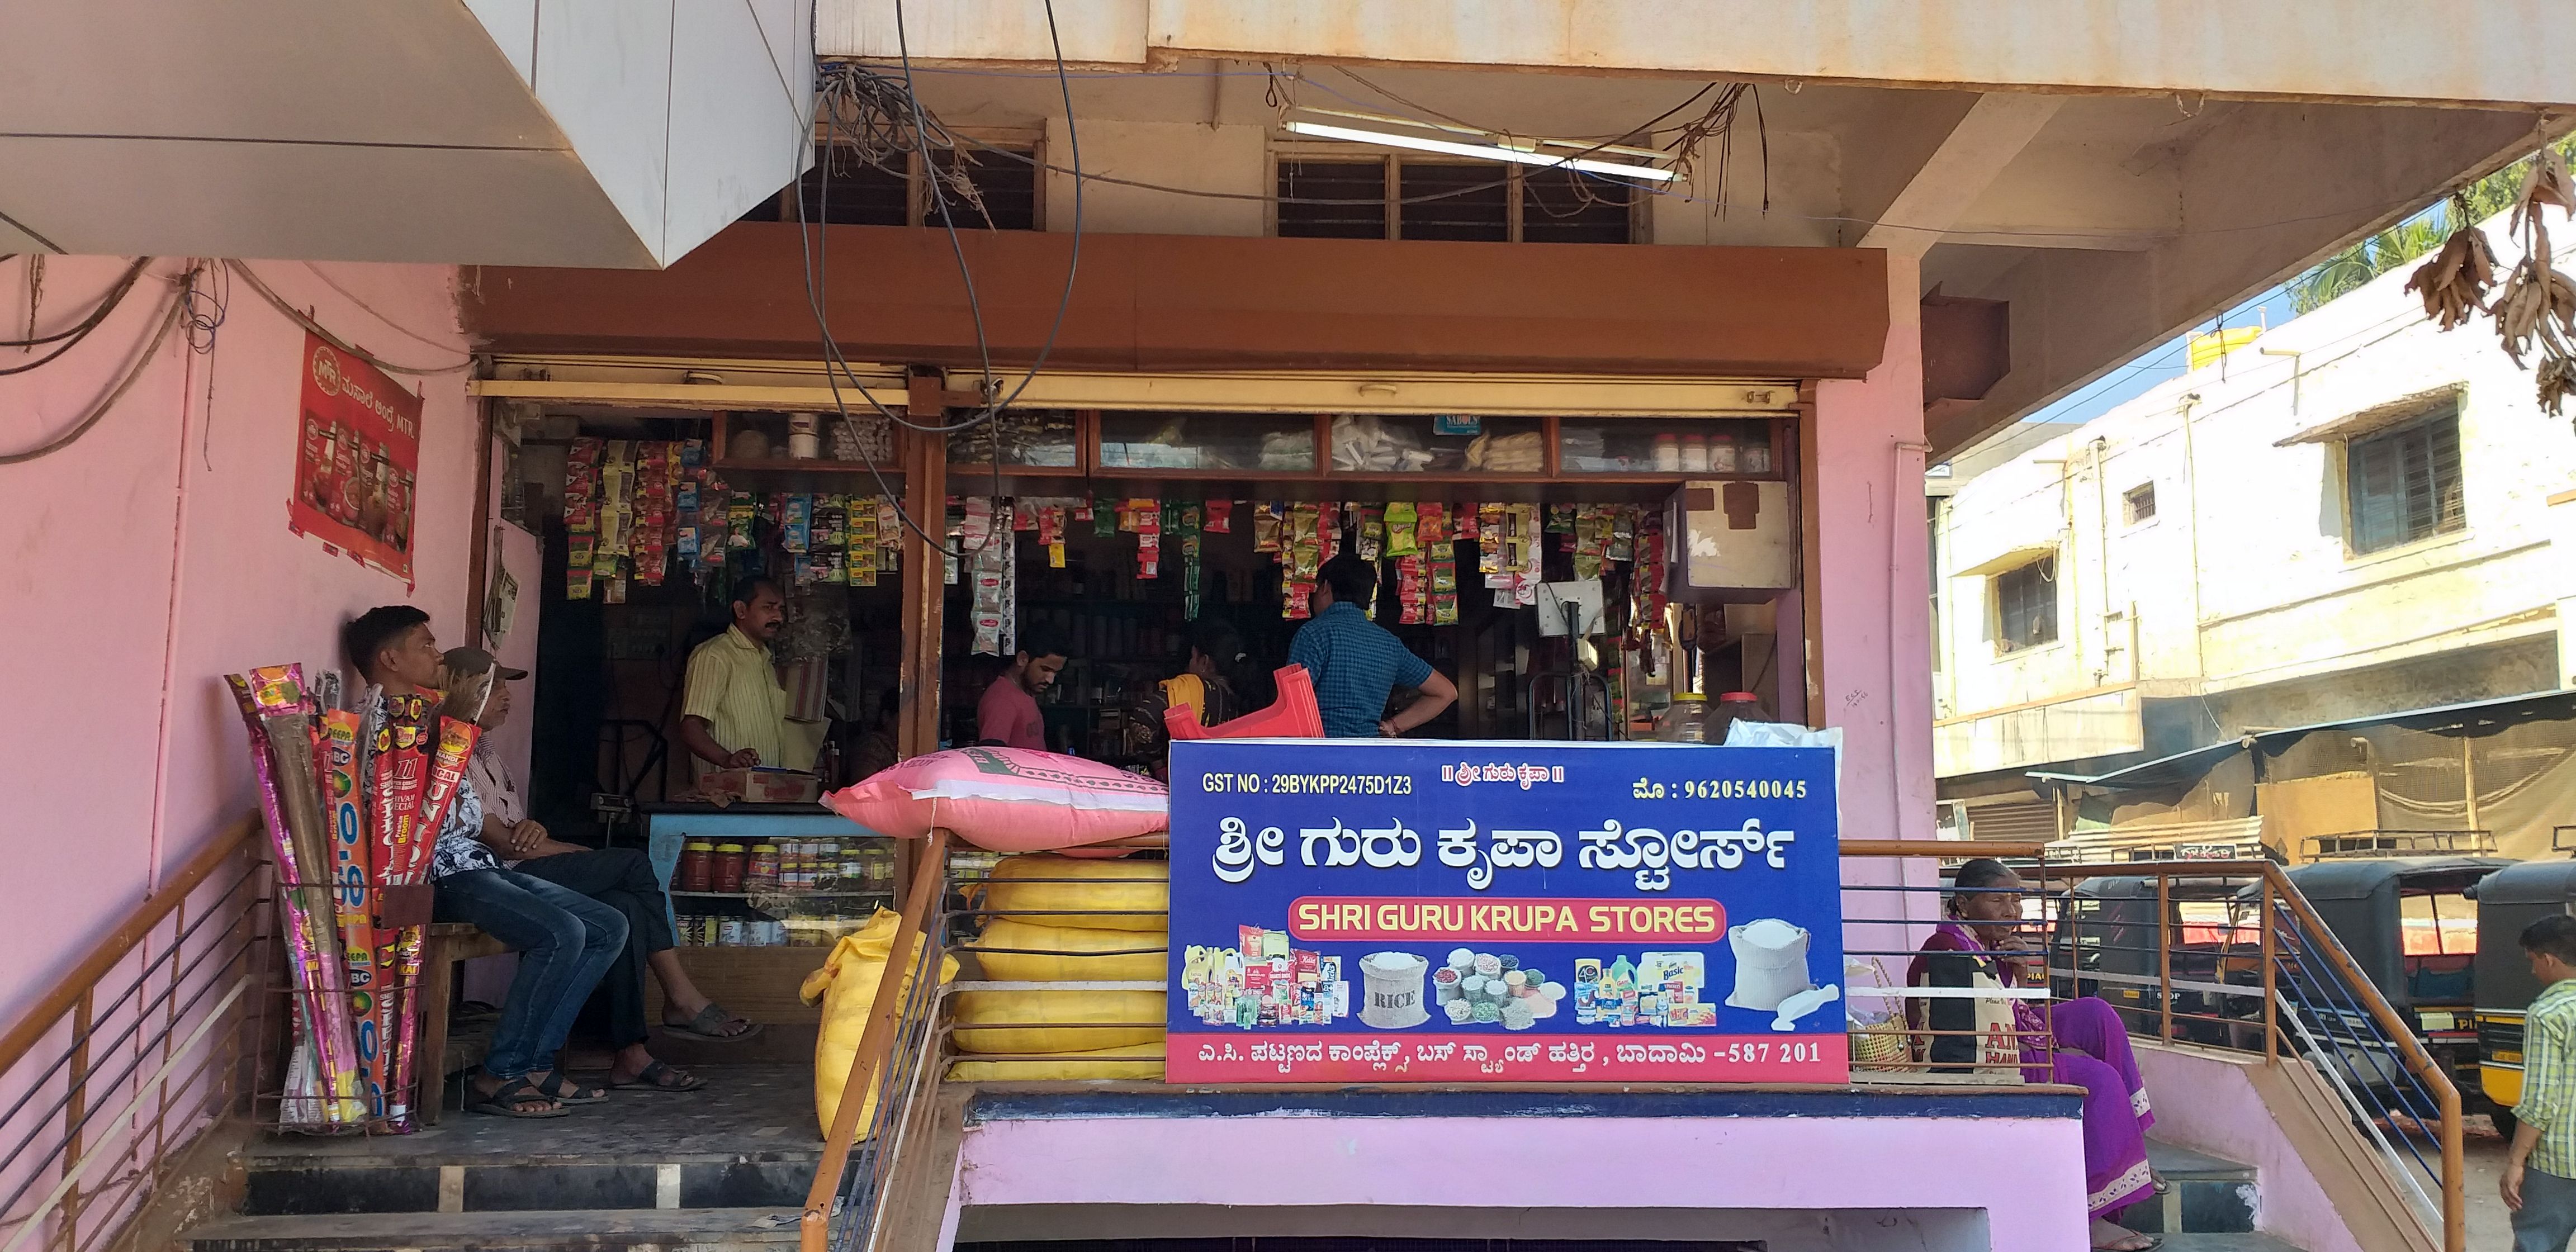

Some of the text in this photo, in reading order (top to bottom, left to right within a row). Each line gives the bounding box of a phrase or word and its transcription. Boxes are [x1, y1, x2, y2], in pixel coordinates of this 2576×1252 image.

[319, 359, 335, 386] MTR
[397, 414, 414, 439] MTR
[334, 752, 349, 763] BC
[1202, 773, 1233, 793] GST
[1237, 774, 1260, 793] NO
[1272, 774, 1412, 794] 29BYKPP2475D1Z3
[1455, 762, 1481, 786] ಶ್ರೀ
[1483, 763, 1516, 781] ಗುರು
[1517, 763, 1550, 790] ಕೃಪಾ
[1684, 780, 1807, 799] 9620540045
[397, 814, 409, 843] Broom
[1212, 817, 1794, 890] ಶ್ರೀ ಗುರು ಕೃಪಾ ಸ್ಟೋರ್ಸ್
[1298, 904, 1715, 932] SHRI GURU KRUPA STORES
[351, 973, 370, 983] BC
[1663, 966, 1684, 980] Basic
[1374, 990, 1415, 1008] RICE
[1251, 1041, 1323, 1073] ಪಟ್ಟಣದ
[1416, 1042, 1456, 1061] ಬಸ್
[1548, 1042, 1595, 1072] ಹತ್ತಿರ
[1616, 1042, 1706, 1063] ಬಾದಾಮಿ
[1779, 1043, 1821, 1063] 201
